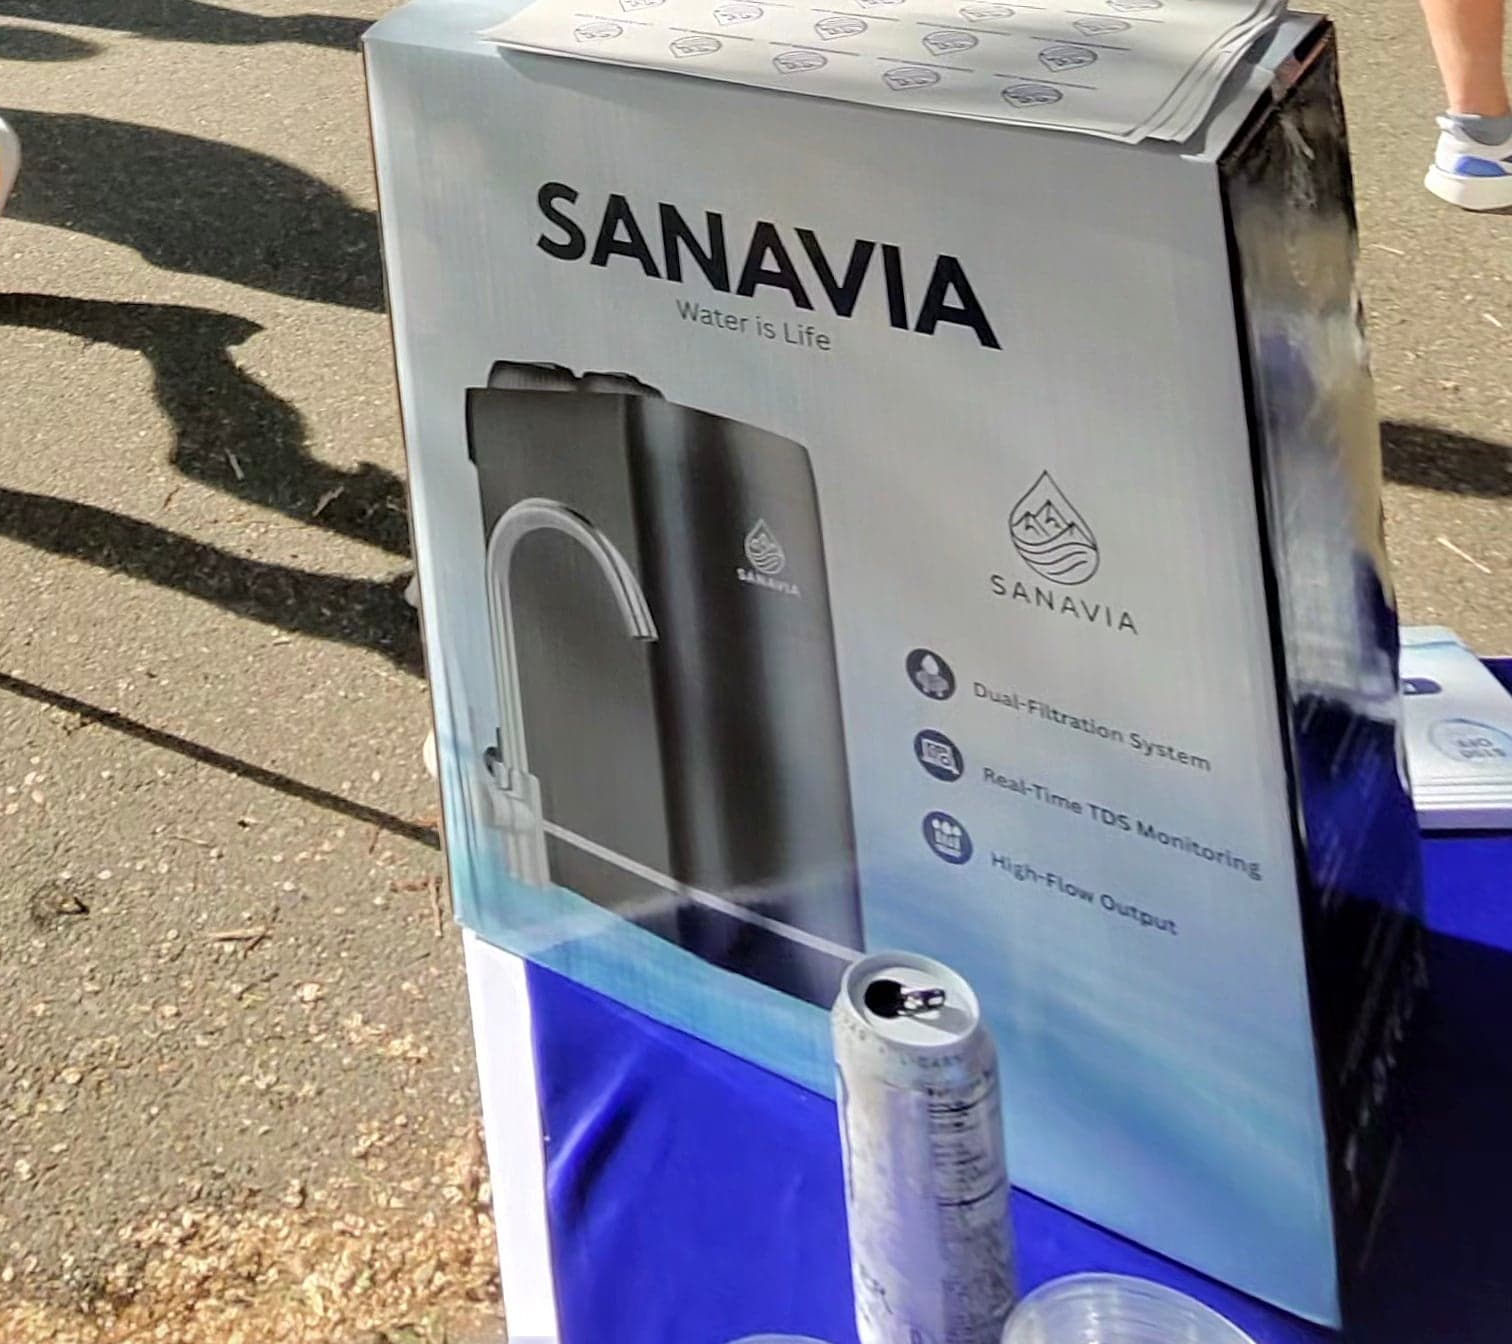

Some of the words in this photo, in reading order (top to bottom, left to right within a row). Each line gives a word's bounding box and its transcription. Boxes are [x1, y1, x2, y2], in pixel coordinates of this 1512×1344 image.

[537, 181, 1003, 351] SANAVIA
[676, 299, 748, 334] Water
[756, 315, 777, 340] is
[784, 322, 832, 351] Life
[990, 574, 1139, 635] SANAVIA
[973, 681, 1124, 742] Dual-Filtration
[1130, 732, 1212, 773] System
[983, 767, 1083, 815] Real-Time
[1087, 804, 1131, 832] TDS
[1136, 820, 1263, 881] Monitoring
[991, 852, 1094, 904] High-Flow
[1100, 894, 1180, 937] Output
